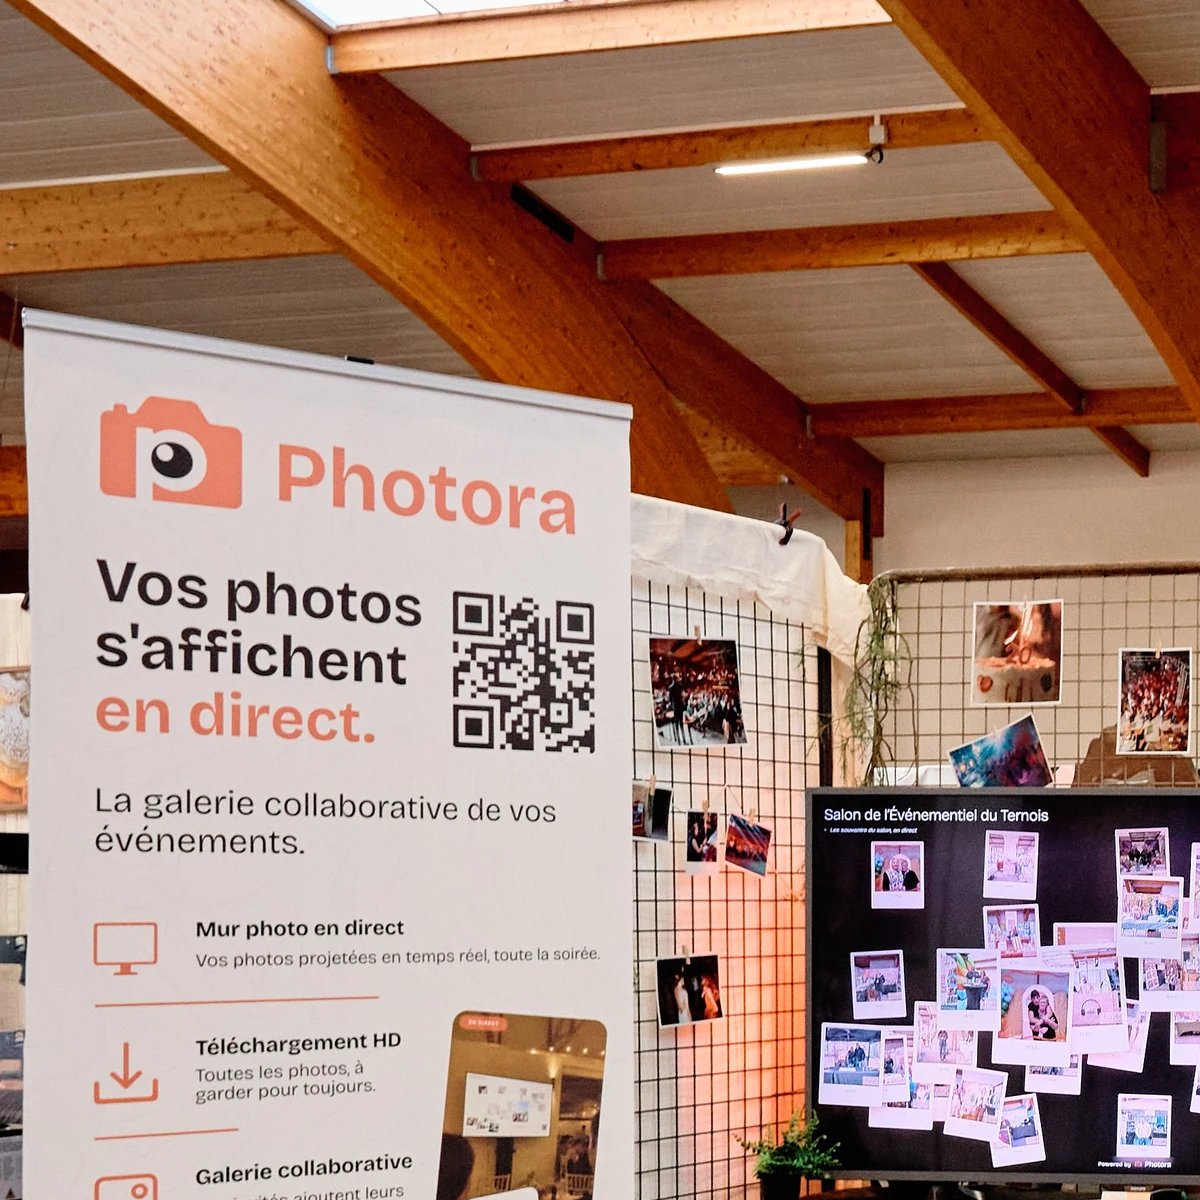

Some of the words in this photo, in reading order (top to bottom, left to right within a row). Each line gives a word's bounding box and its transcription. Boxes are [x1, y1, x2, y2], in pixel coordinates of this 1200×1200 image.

[277, 443, 577, 535] Photora
[96, 559, 209, 609] Vos
[227, 571, 423, 627] photos
[96, 624, 407, 686] s'affichent
[96, 696, 170, 734] en
[190, 692, 375, 744] direct.
[96, 787, 132, 814] La
[143, 790, 254, 819] galerie
[265, 792, 458, 821] collaborative
[467, 795, 500, 823] de
[511, 799, 557, 823] vos
[824, 808, 861, 821] Salon
[865, 808, 881, 821] de
[885, 806, 977, 822] l'Événementiel
[981, 810, 997, 822] du
[1001, 809, 1049, 822] Ternois
[95, 825, 305, 856] événements.
[196, 920, 240, 937] Mur
[246, 920, 308, 939] photo
[314, 921, 338, 935] en
[345, 919, 404, 935] direct
[196, 953, 227, 967] Vos
[233, 950, 293, 968] photos
[298, 948, 376, 967] projetées
[382, 951, 401, 963] en
[406, 949, 454, 966] temps
[458, 948, 489, 963] réel,
[494, 948, 531, 961] toute
[536, 948, 549, 960] la
[553, 948, 600, 961] soirée.
[196, 1035, 368, 1056] Téléchargement
[373, 1033, 401, 1048] HD
[196, 1067, 253, 1082] Toutes
[259, 1065, 282, 1079] les
[288, 1062, 350, 1082] photos,
[354, 1060, 364, 1074] à
[196, 1086, 252, 1104] garder
[259, 1083, 297, 1099] pour
[303, 1079, 376, 1098] toujours.
[196, 1164, 272, 1185] Galerie
[278, 1154, 413, 1178] collaborative
[366, 1185, 404, 1200] leurs
